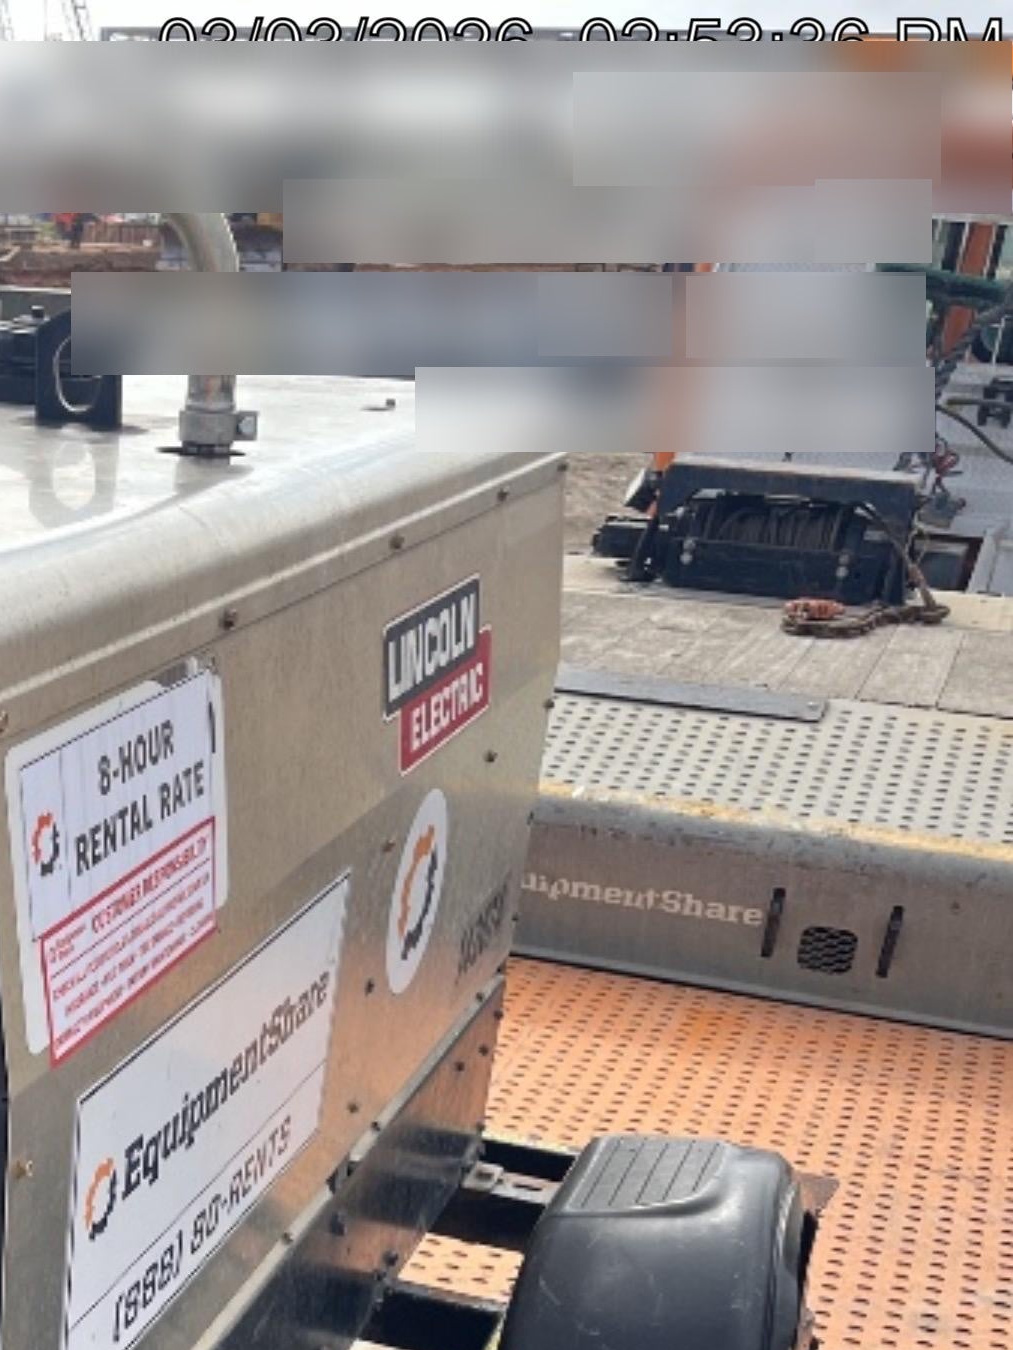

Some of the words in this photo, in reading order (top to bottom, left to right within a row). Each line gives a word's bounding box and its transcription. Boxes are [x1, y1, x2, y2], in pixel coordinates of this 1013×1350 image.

[388, 592, 477, 703] LINCOLN
[98, 719, 175, 796] 8-HOUR
[410, 661, 485, 754] ELECTRIC
[75, 794, 154, 877] RENTAL
[158, 758, 205, 831] RATE
[121, 970, 330, 1202] EquipmentShare
[113, 1230, 184, 1343] (888)
[190, 1116, 292, 1256] 80-RENTS
